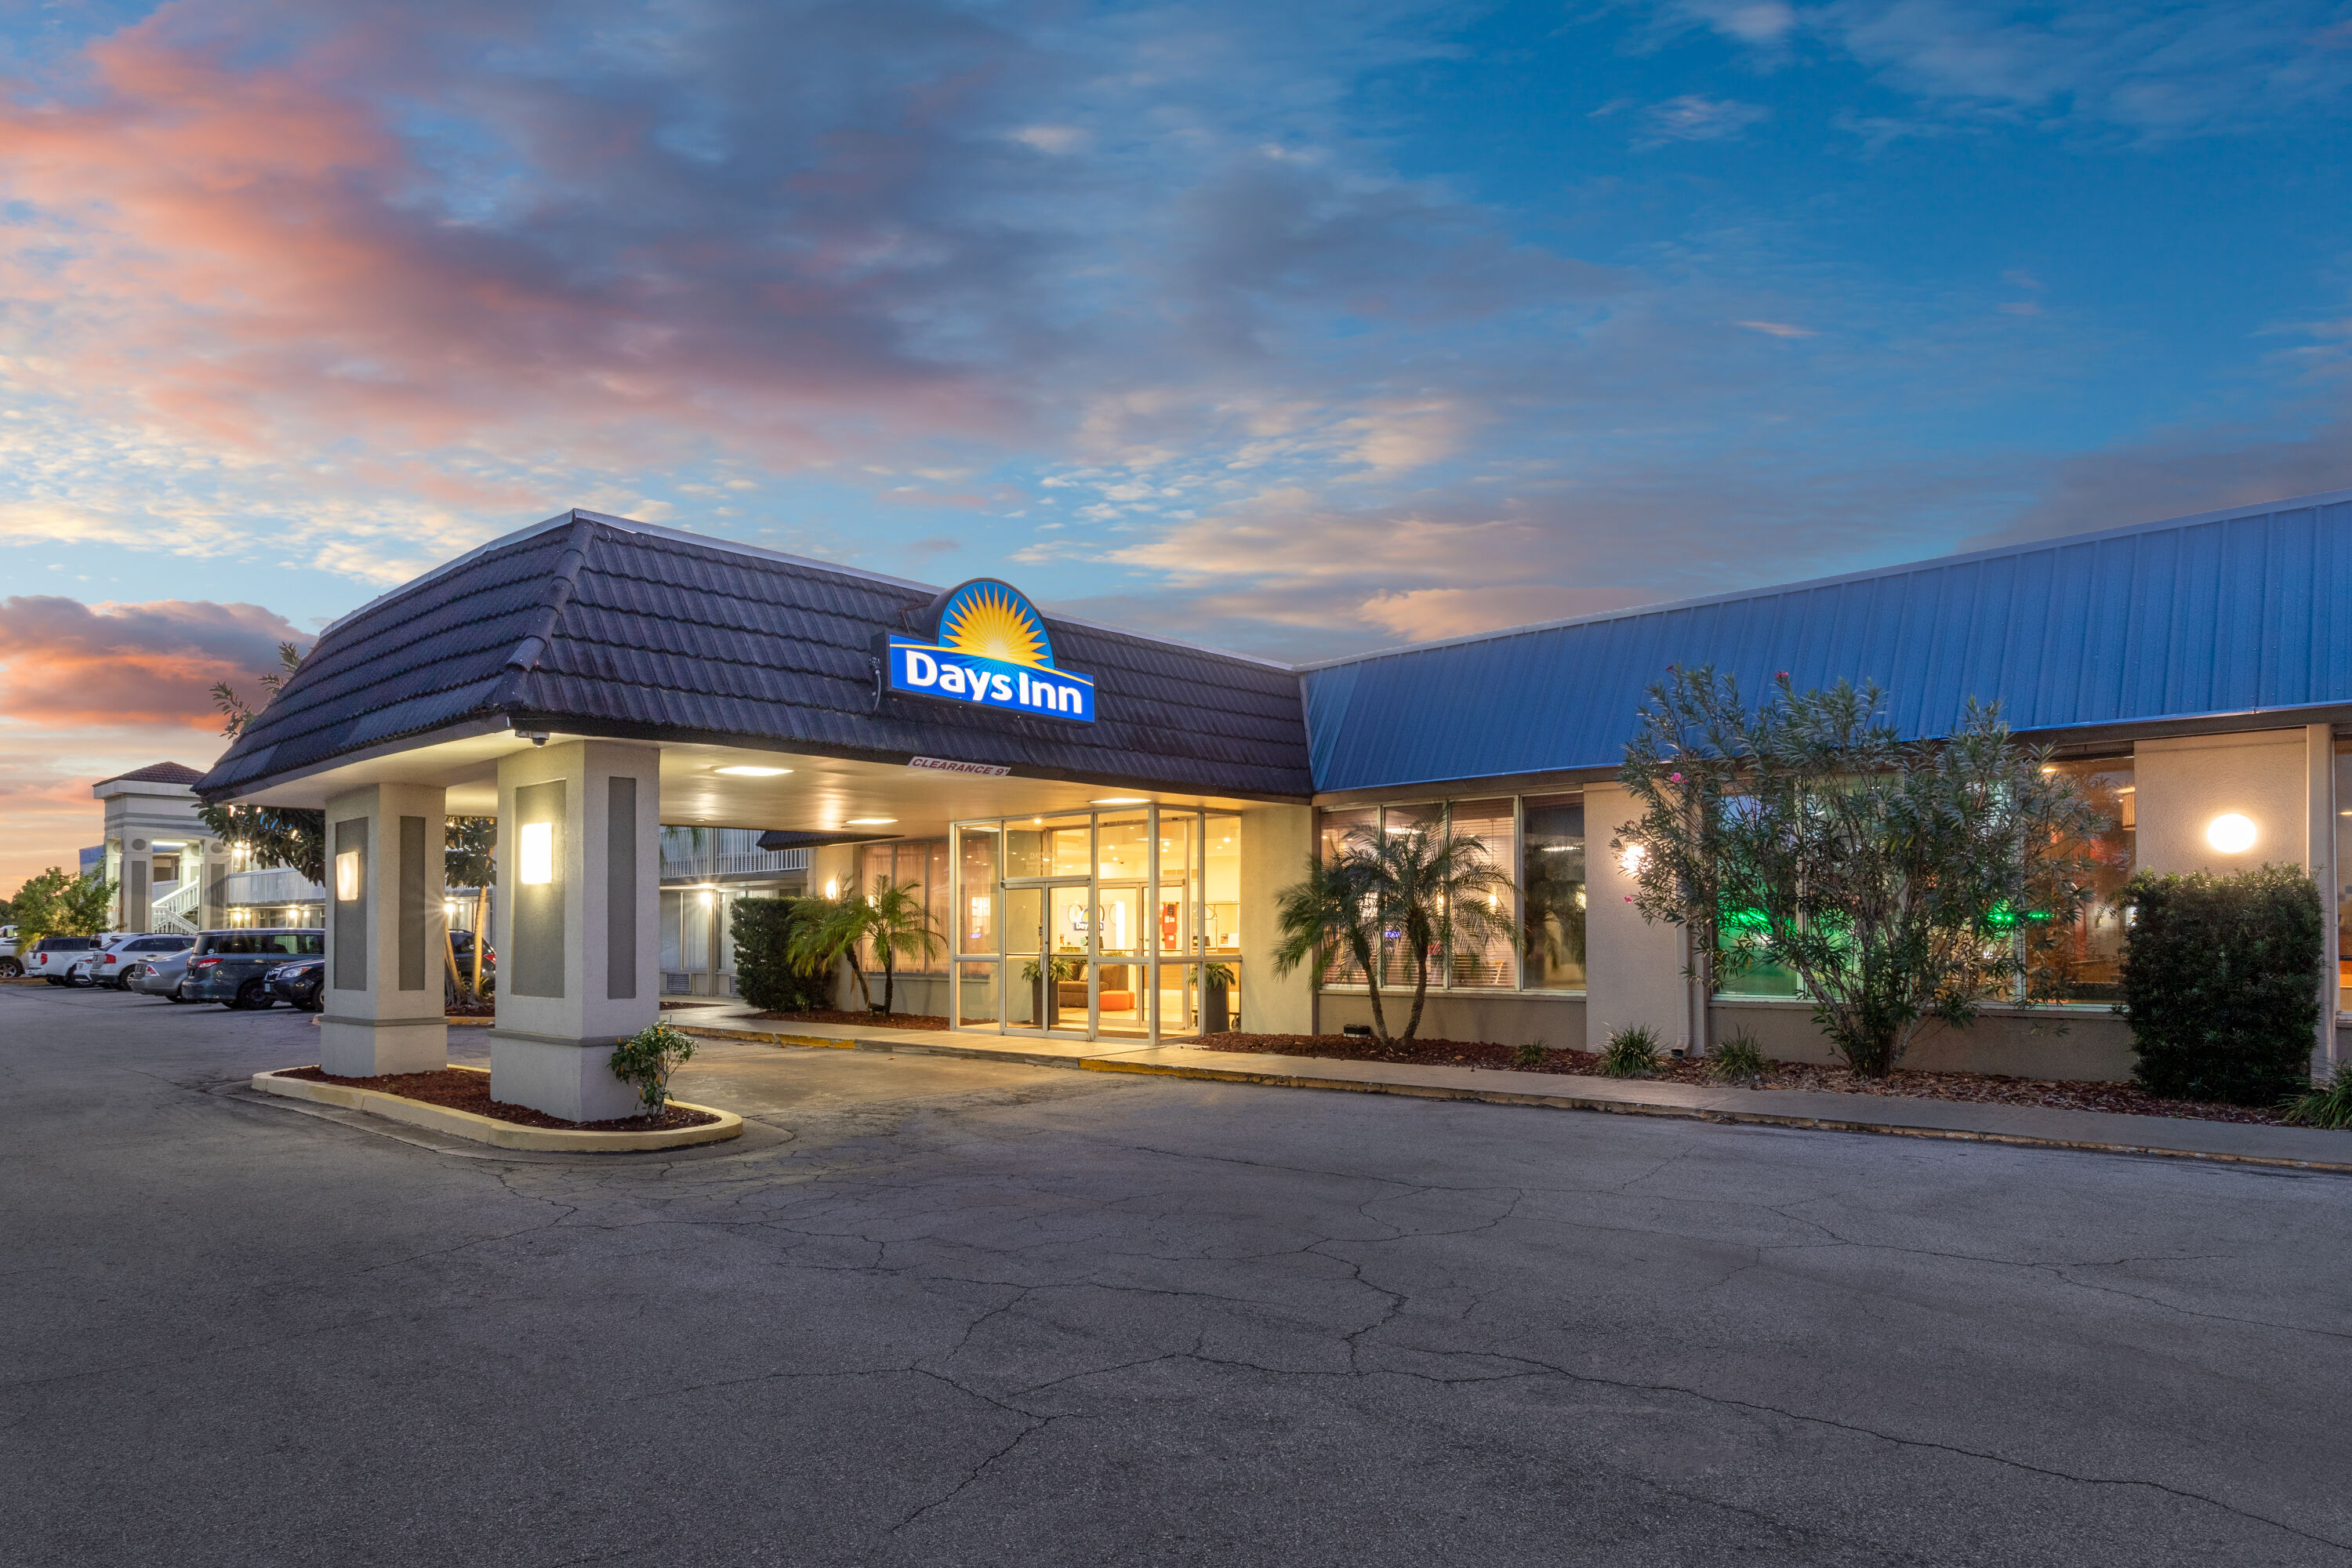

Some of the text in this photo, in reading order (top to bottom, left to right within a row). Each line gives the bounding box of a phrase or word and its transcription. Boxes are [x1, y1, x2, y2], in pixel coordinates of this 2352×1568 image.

[906, 650, 1082, 714] Days Inn
[912, 758, 1009, 776] CLEARANCE 9'
